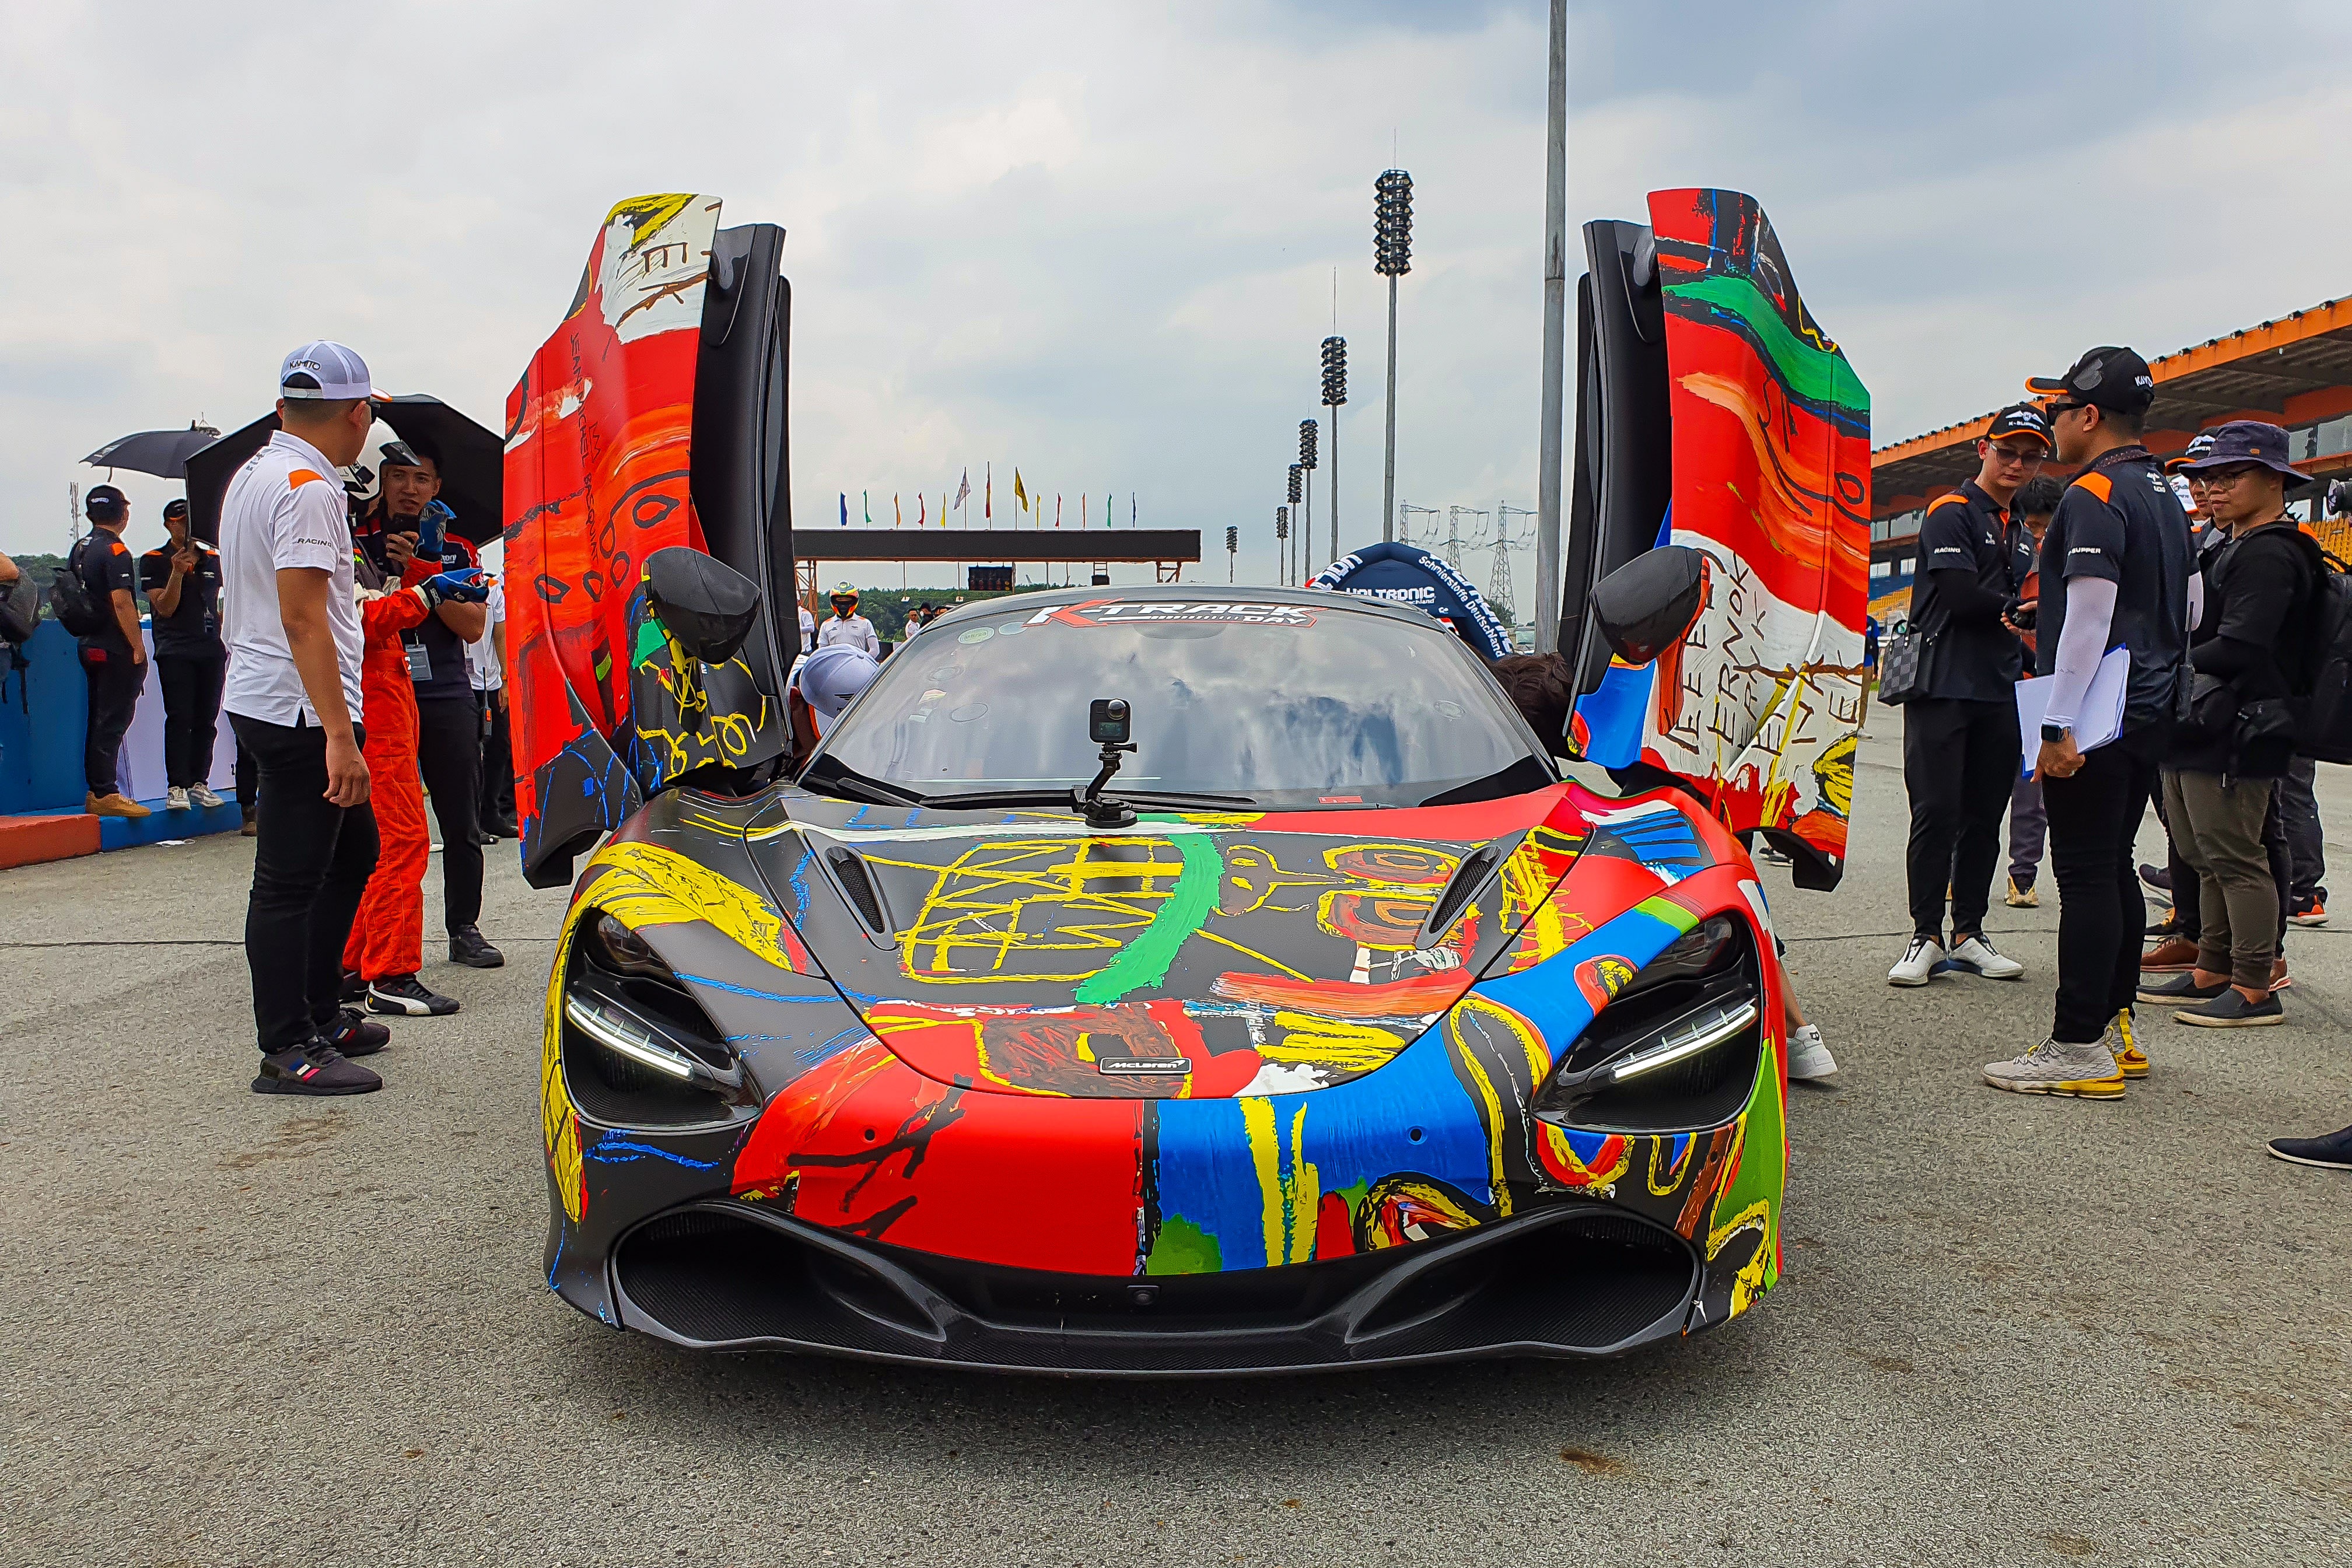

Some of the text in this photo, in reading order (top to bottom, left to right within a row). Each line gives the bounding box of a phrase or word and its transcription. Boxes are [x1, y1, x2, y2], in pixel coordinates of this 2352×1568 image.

[289, 360, 321, 371] KAMITO
[297, 537, 332, 548] RACING
[1934, 546, 1961, 554] RACING
[1022, 597, 1316, 627] K-TRACK
[1418, 555, 1469, 603] Schmierstoffe
[1465, 600, 1506, 658] Deutschland
[1242, 615, 1308, 624] DAY
